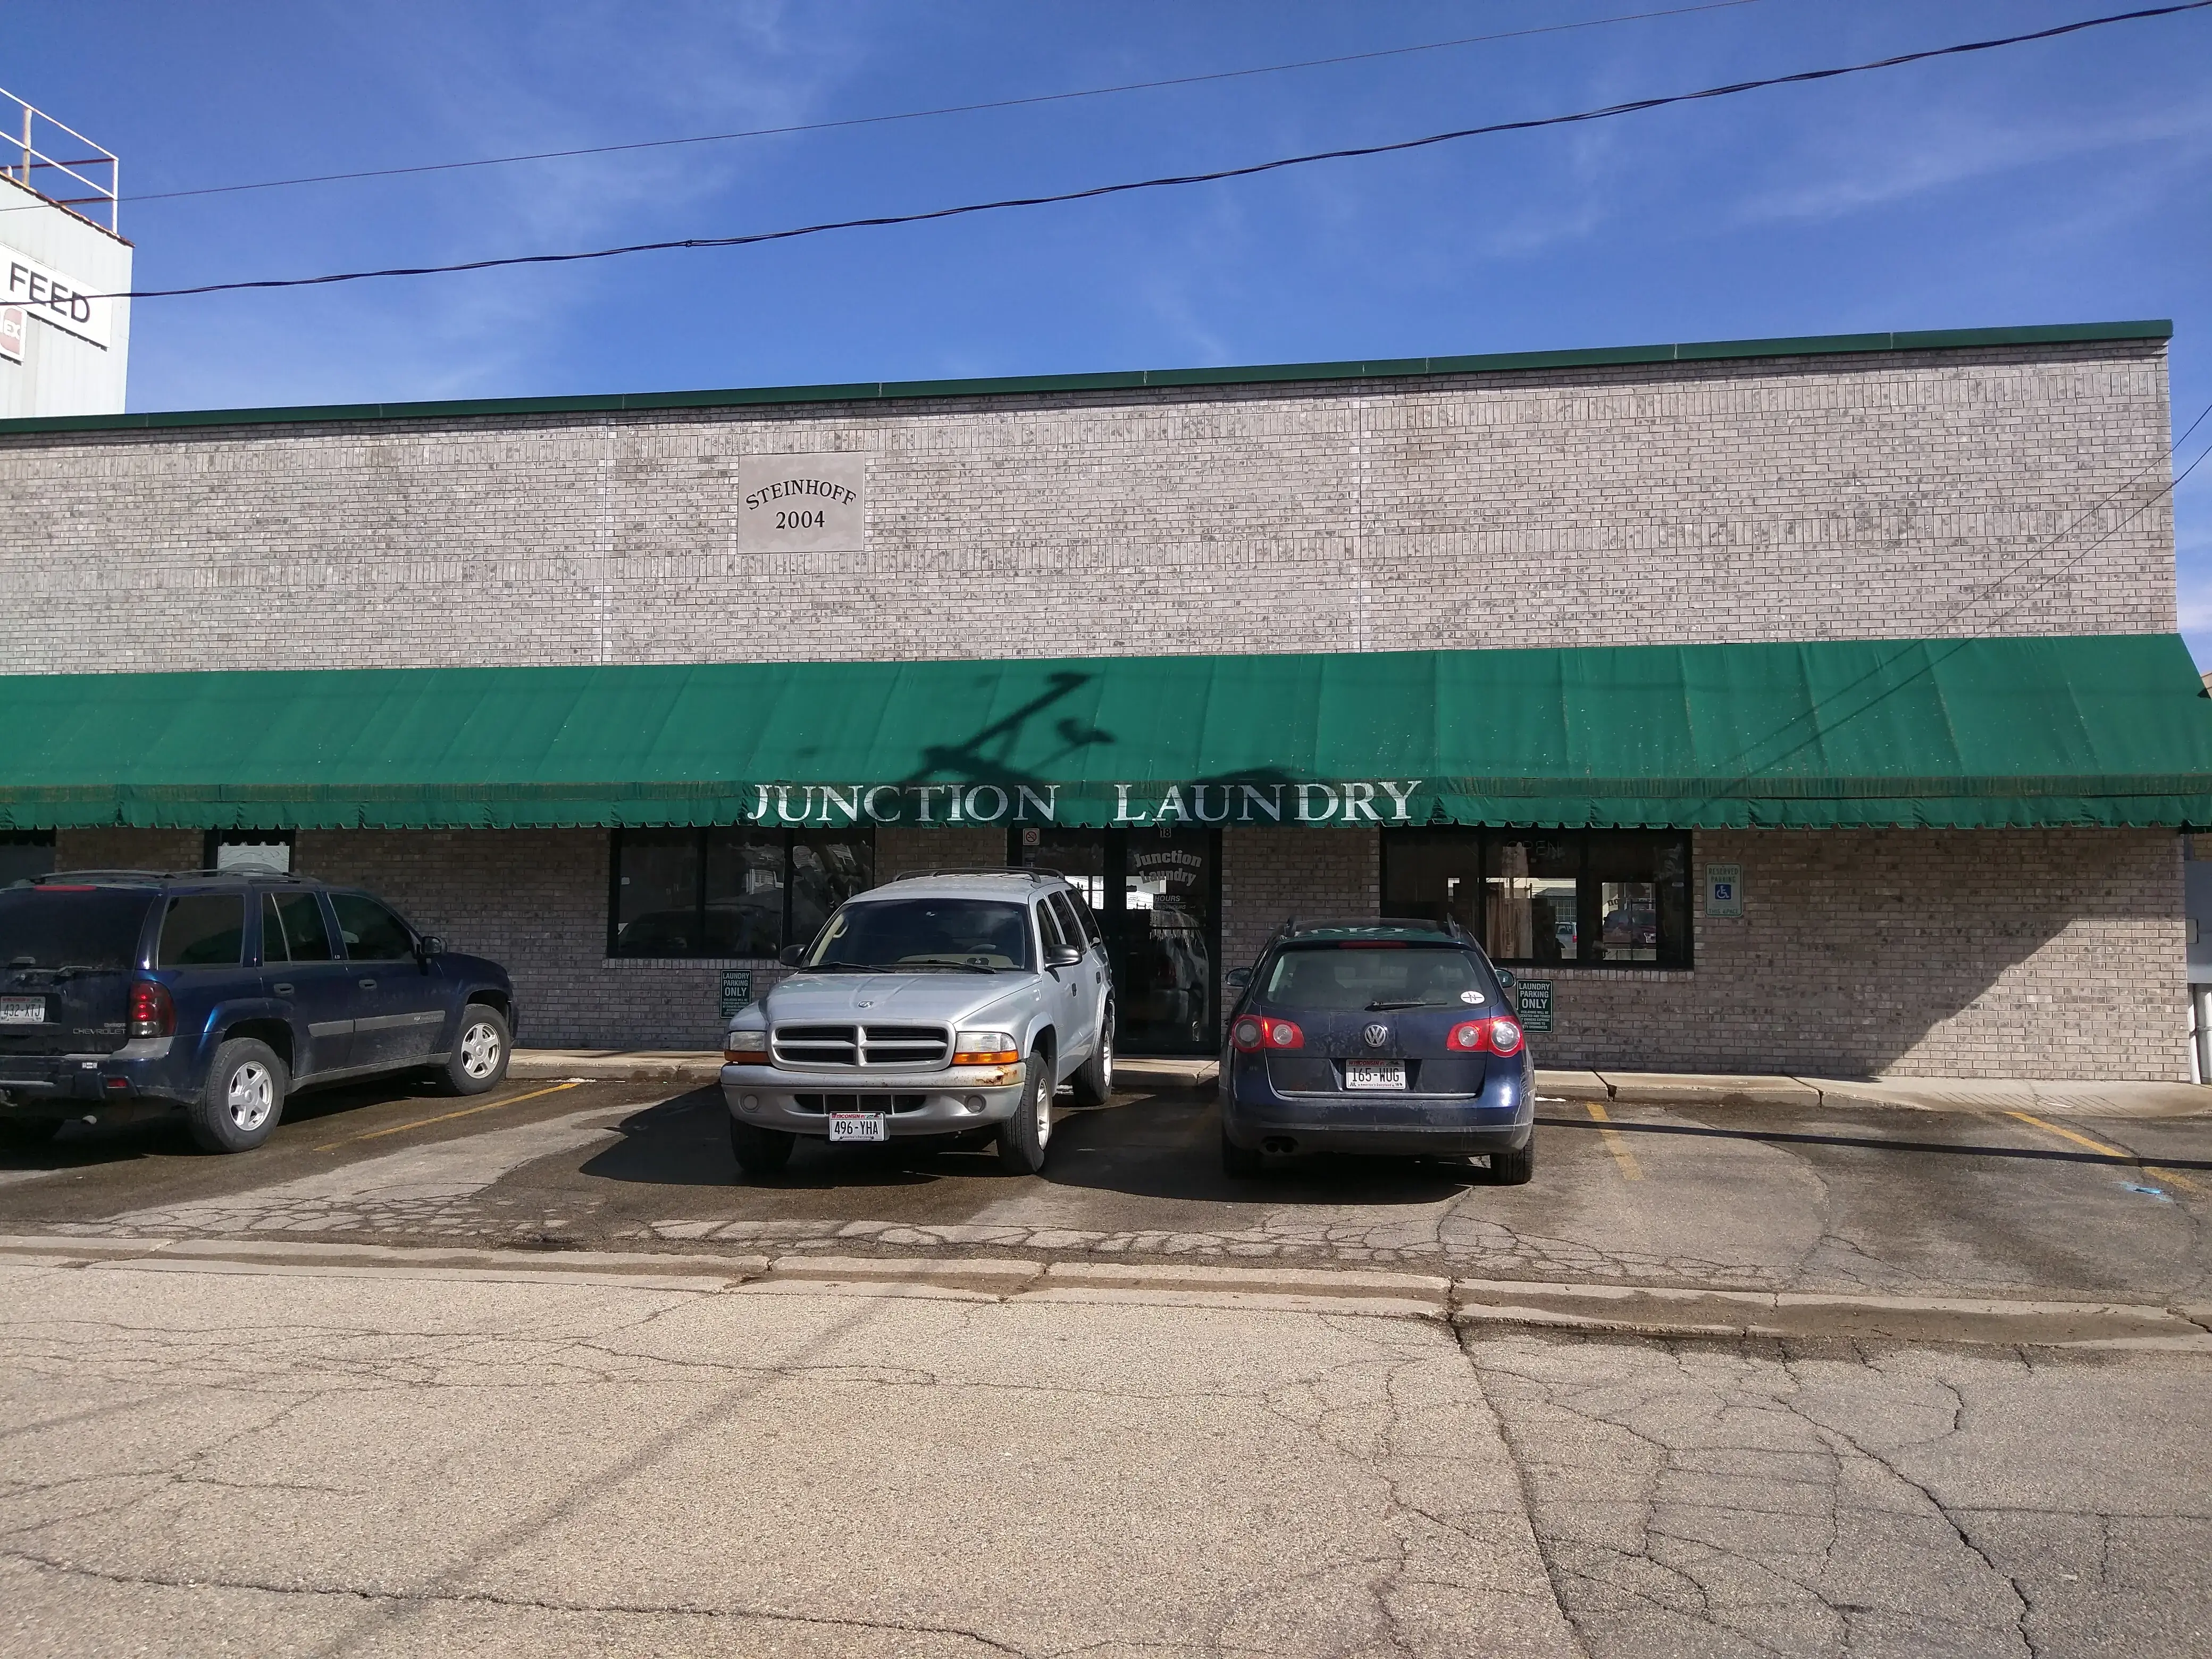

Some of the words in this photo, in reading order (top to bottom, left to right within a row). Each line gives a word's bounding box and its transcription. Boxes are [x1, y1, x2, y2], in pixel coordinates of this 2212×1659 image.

[10, 261, 90, 323] FEED
[745, 479, 857, 510] STEINHOFF
[775, 510, 825, 530] 2004
[747, 784, 1060, 822] JUNCTION
[1113, 781, 1422, 822] LAUNDRY
[1160, 828, 1171, 837] 18
[1134, 850, 1202, 868] Junction
[1138, 868, 1196, 887] Laundry
[725, 987, 747, 996] ONLY
[4, 1004, 41, 1017] 432-XTJ
[1522, 998, 1548, 1009] ONLY
[1352, 1067, 1400, 1082] 165-WUG
[834, 1120, 879, 1135] 496-YHA
